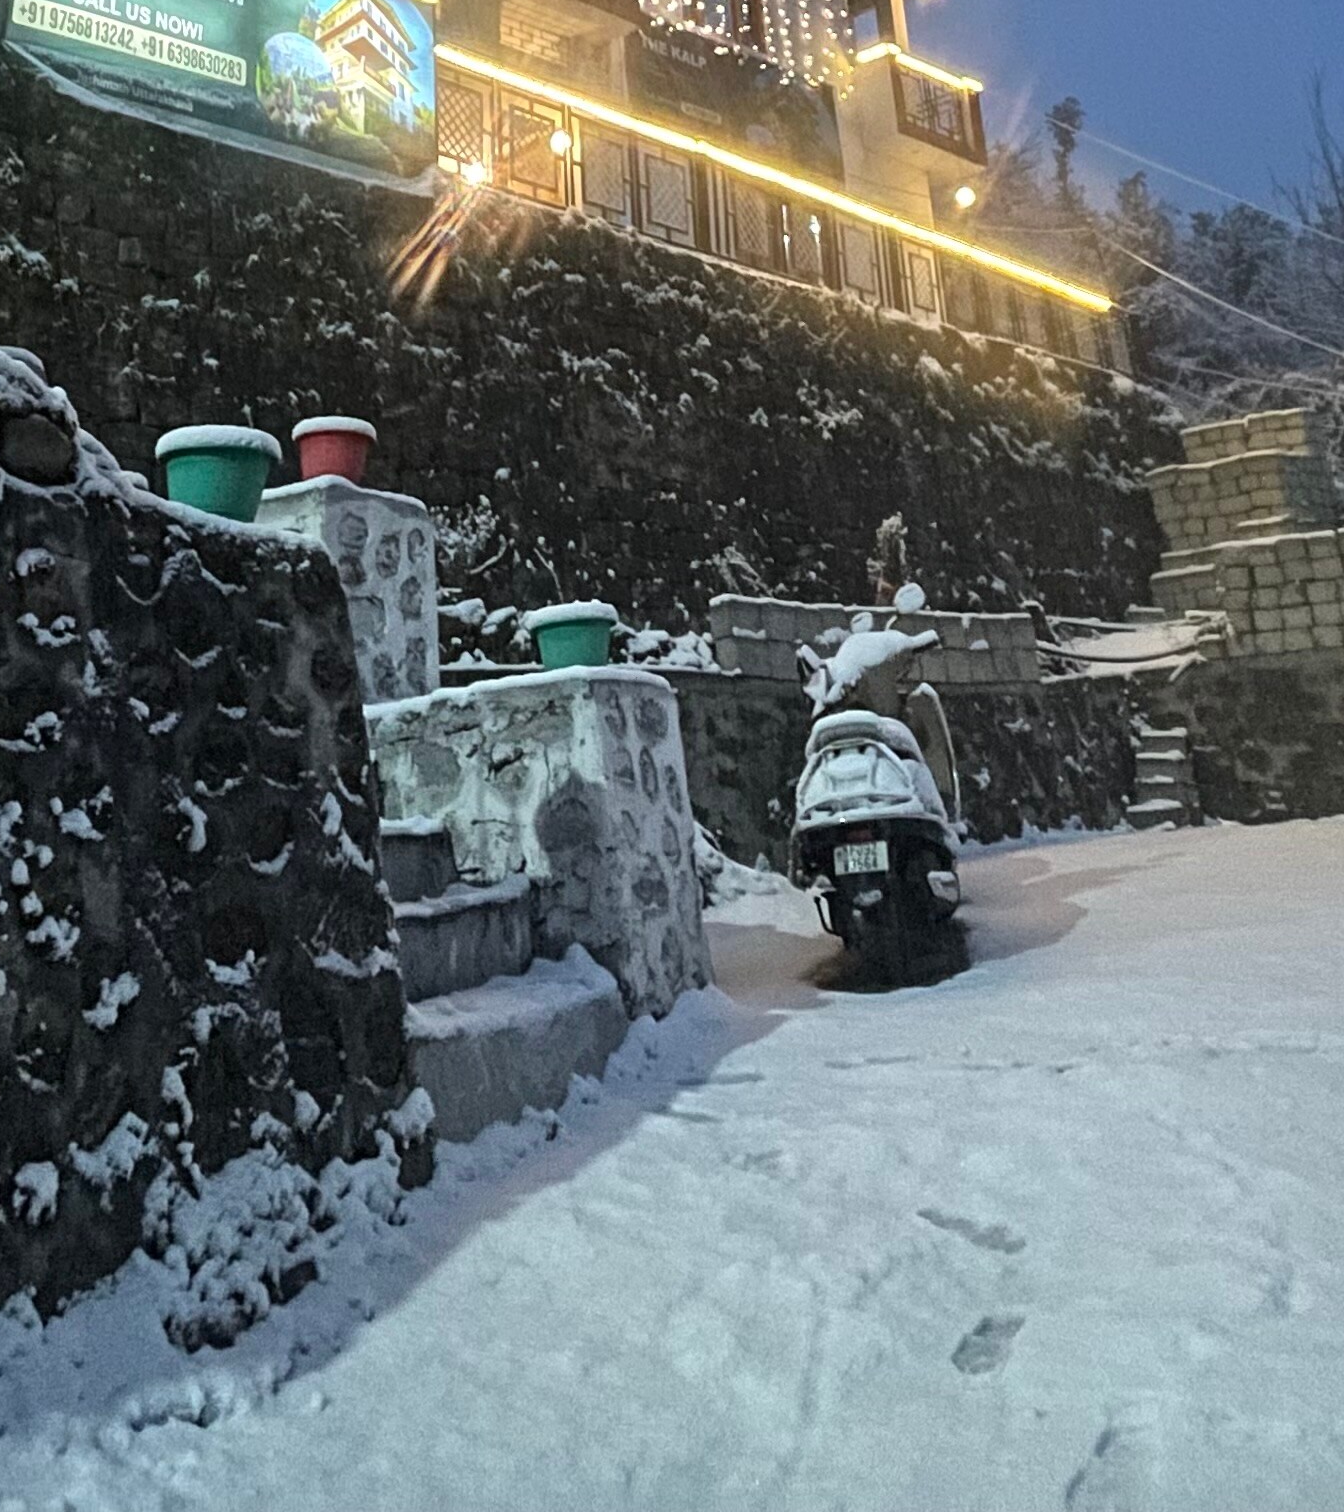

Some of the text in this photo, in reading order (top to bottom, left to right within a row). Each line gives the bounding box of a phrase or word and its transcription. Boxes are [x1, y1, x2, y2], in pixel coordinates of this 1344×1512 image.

[125, 1, 151, 25] US
[155, 10, 204, 41] NOW!
[19, 1, 46, 26] +91
[48, 7, 138, 53] 9756813242,
[141, 35, 164, 59] +91
[167, 41, 242, 82] 6398630283
[670, 44, 707, 70] KALP
